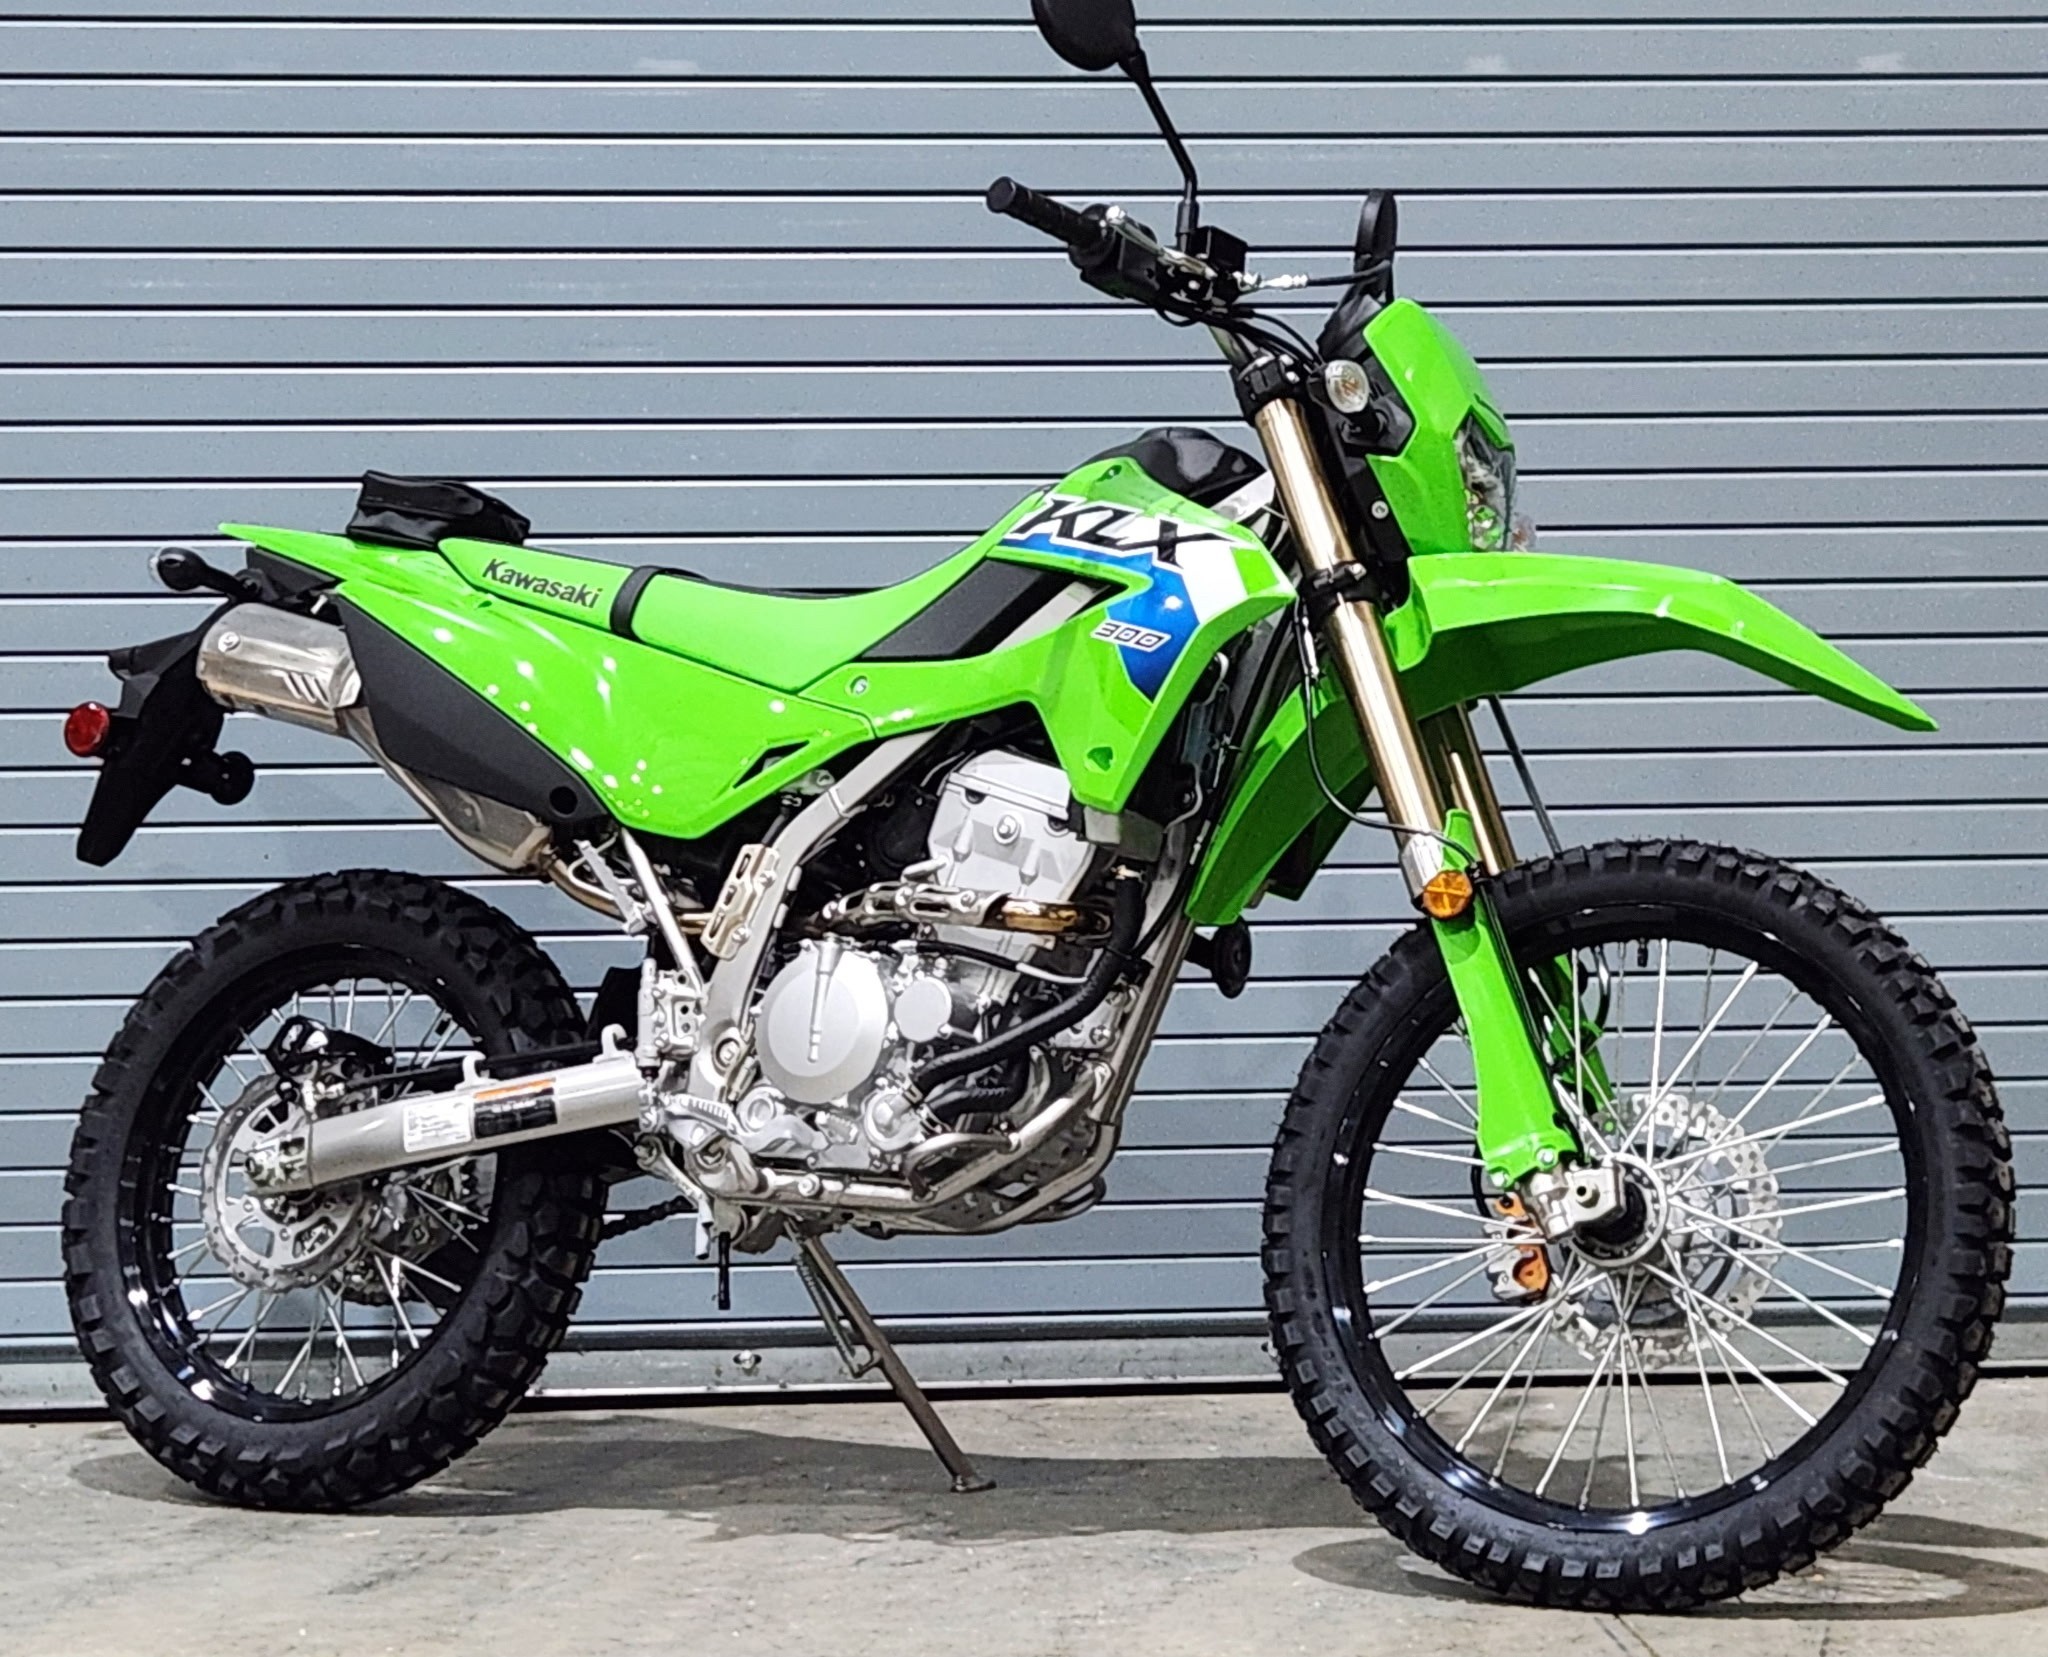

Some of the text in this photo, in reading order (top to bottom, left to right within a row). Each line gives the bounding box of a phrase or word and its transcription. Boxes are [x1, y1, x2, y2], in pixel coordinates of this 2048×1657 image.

[1008, 497, 1235, 570] KLX
[482, 558, 603, 608] Kawasaki
[1094, 621, 1166, 649] 300
